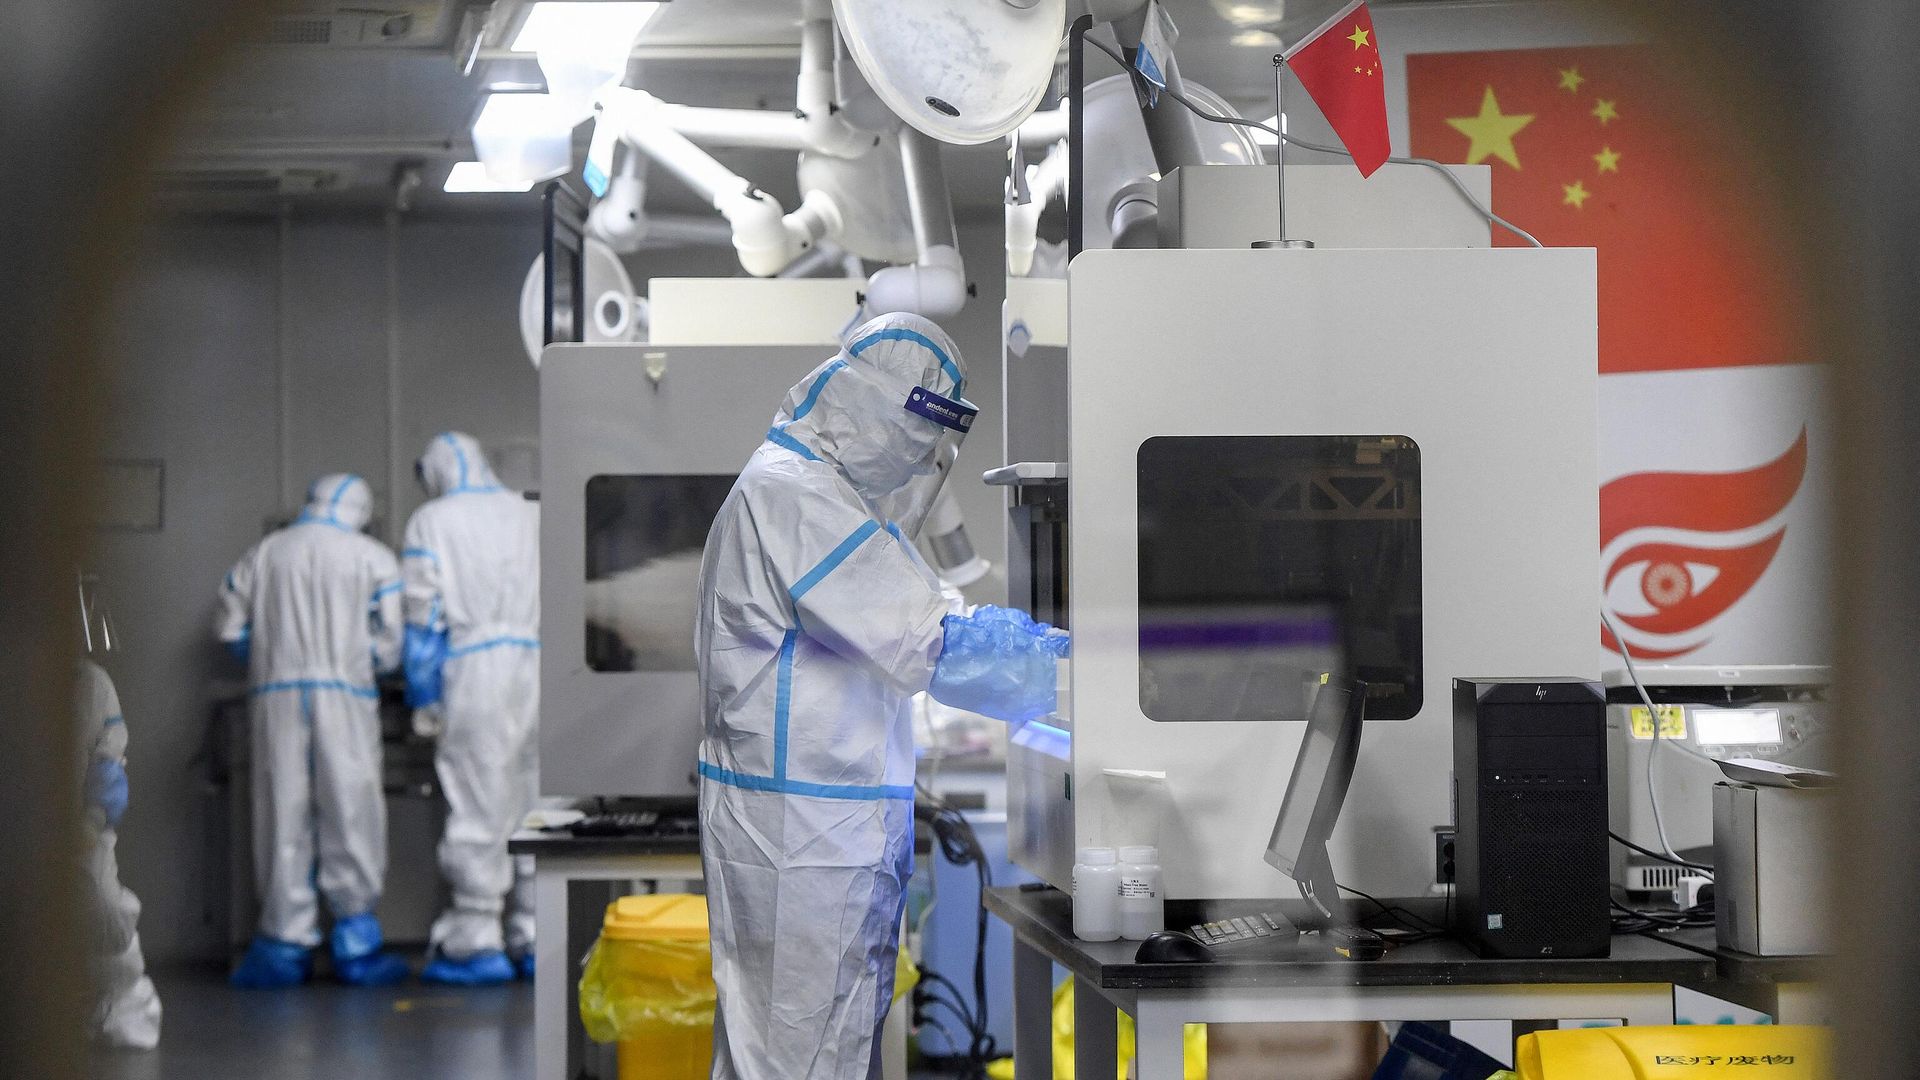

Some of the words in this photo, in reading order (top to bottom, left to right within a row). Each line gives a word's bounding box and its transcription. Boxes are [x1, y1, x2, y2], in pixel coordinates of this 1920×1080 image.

[1535, 685, 1547, 701] hp
[1655, 1054, 1795, 1066] 医疗废物
